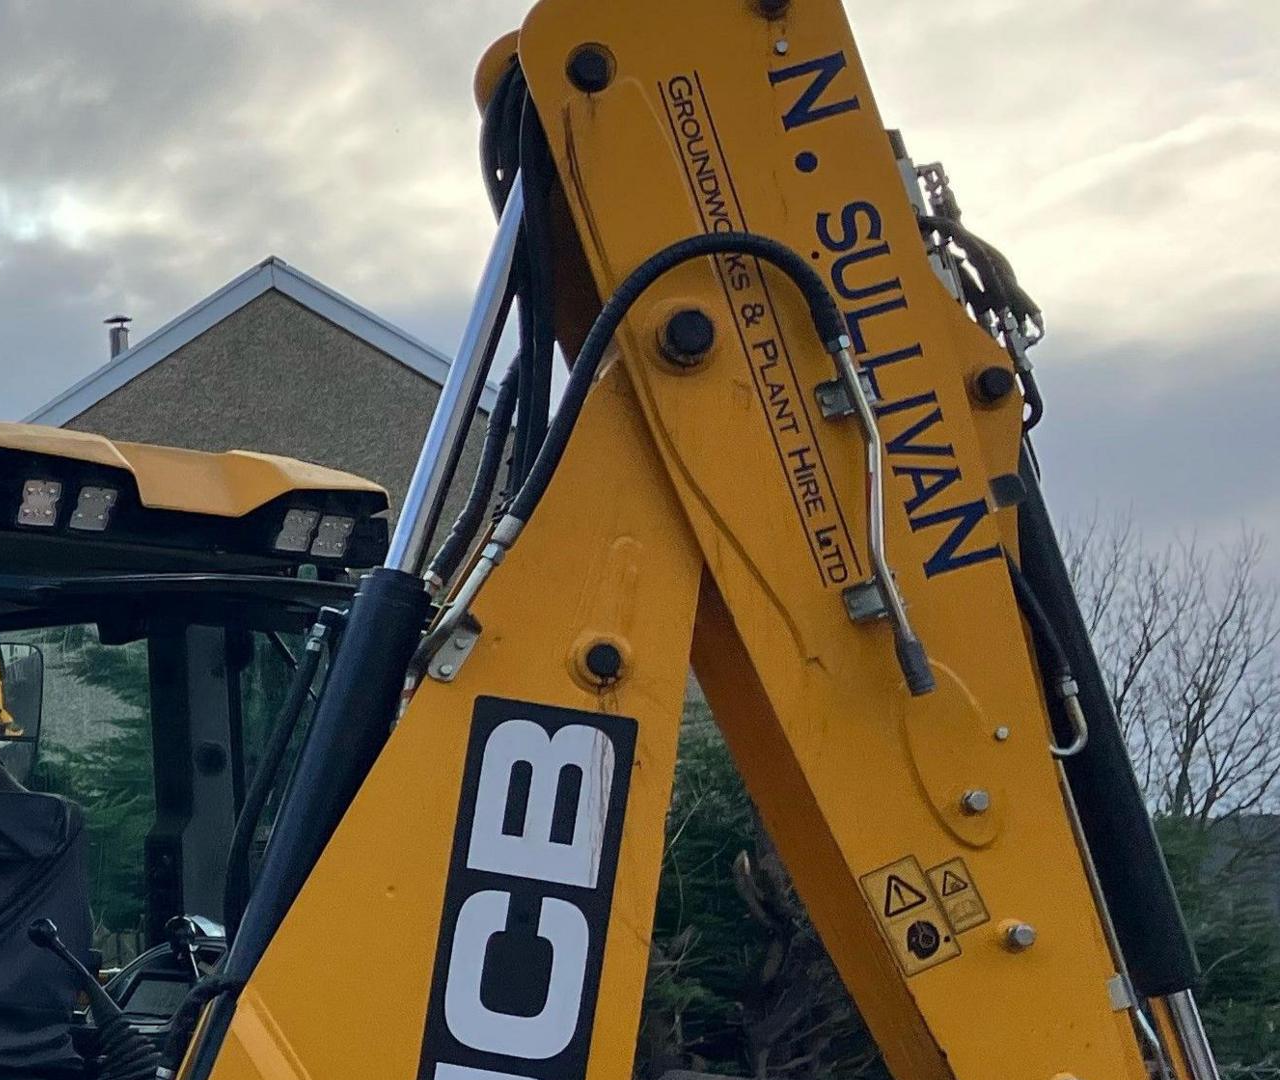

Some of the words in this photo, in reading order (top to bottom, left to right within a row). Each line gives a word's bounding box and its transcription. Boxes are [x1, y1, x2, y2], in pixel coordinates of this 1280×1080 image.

[667, 74, 751, 292] GROUNDWOKS
[741, 303, 765, 329] &
[768, 52, 861, 173] N.
[815, 200, 1004, 580] SULLIVAN
[752, 338, 800, 435] PLANT
[787, 445, 826, 518] HIRE
